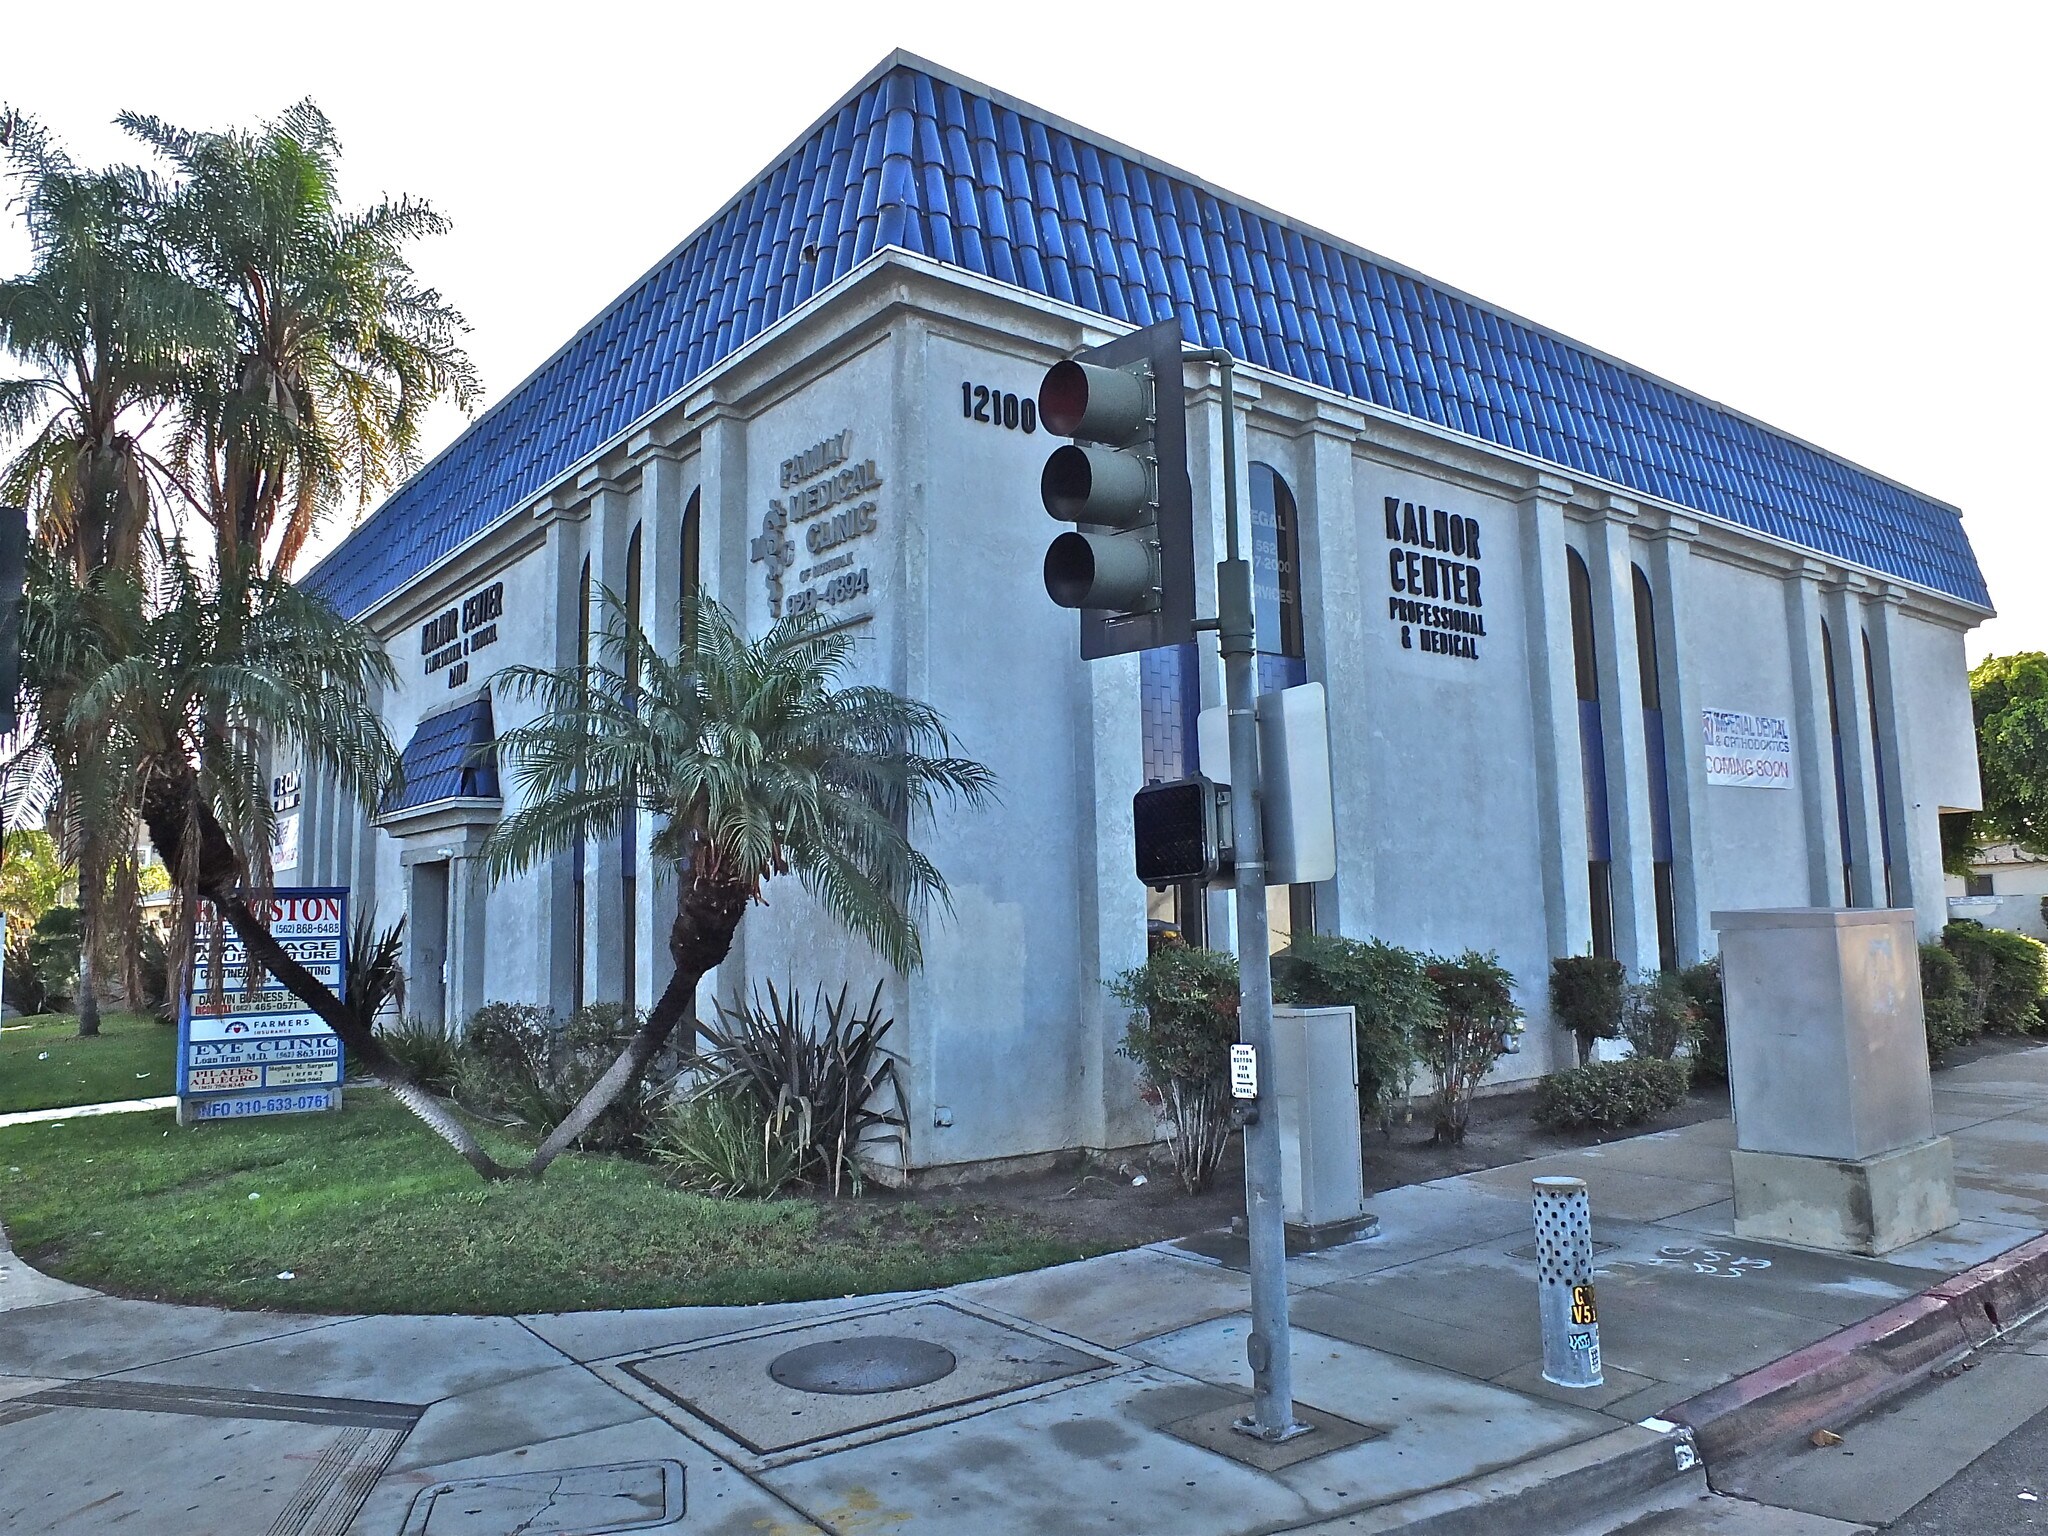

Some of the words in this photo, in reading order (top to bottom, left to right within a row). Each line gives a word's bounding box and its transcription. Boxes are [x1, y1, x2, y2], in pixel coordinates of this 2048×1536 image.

[962, 381, 1036, 434] 12100
[780, 429, 852, 488] FAMILY
[789, 459, 882, 523] MEDICAL
[806, 501, 876, 554] CLINIC
[1251, 509, 1286, 531] EGAL
[1384, 497, 1481, 560] KALNOR
[1255, 555, 1292, 574] 7-2000
[1389, 548, 1482, 607] CENTER
[1254, 583, 1294, 605] RVICES
[462, 582, 503, 633] CENTER
[1389, 597, 1487, 636] PROFESSIONAL
[1401, 625, 1412, 649] &
[1420, 628, 1479, 660] MEDICAL
[1706, 756, 1753, 776] COMING
[1756, 759, 1789, 778] SOON
[199, 994, 235, 1006] DAIN
[254, 1019, 310, 1028] FARMERS
[196, 1042, 244, 1056] EYE
[256, 1037, 338, 1052] CLINIC
[194, 1056, 218, 1065] Loan
[220, 1054, 241, 1063] Tran
[190, 1075, 258, 1085] ALLEGRO
[196, 1067, 253, 1078] PILATES
